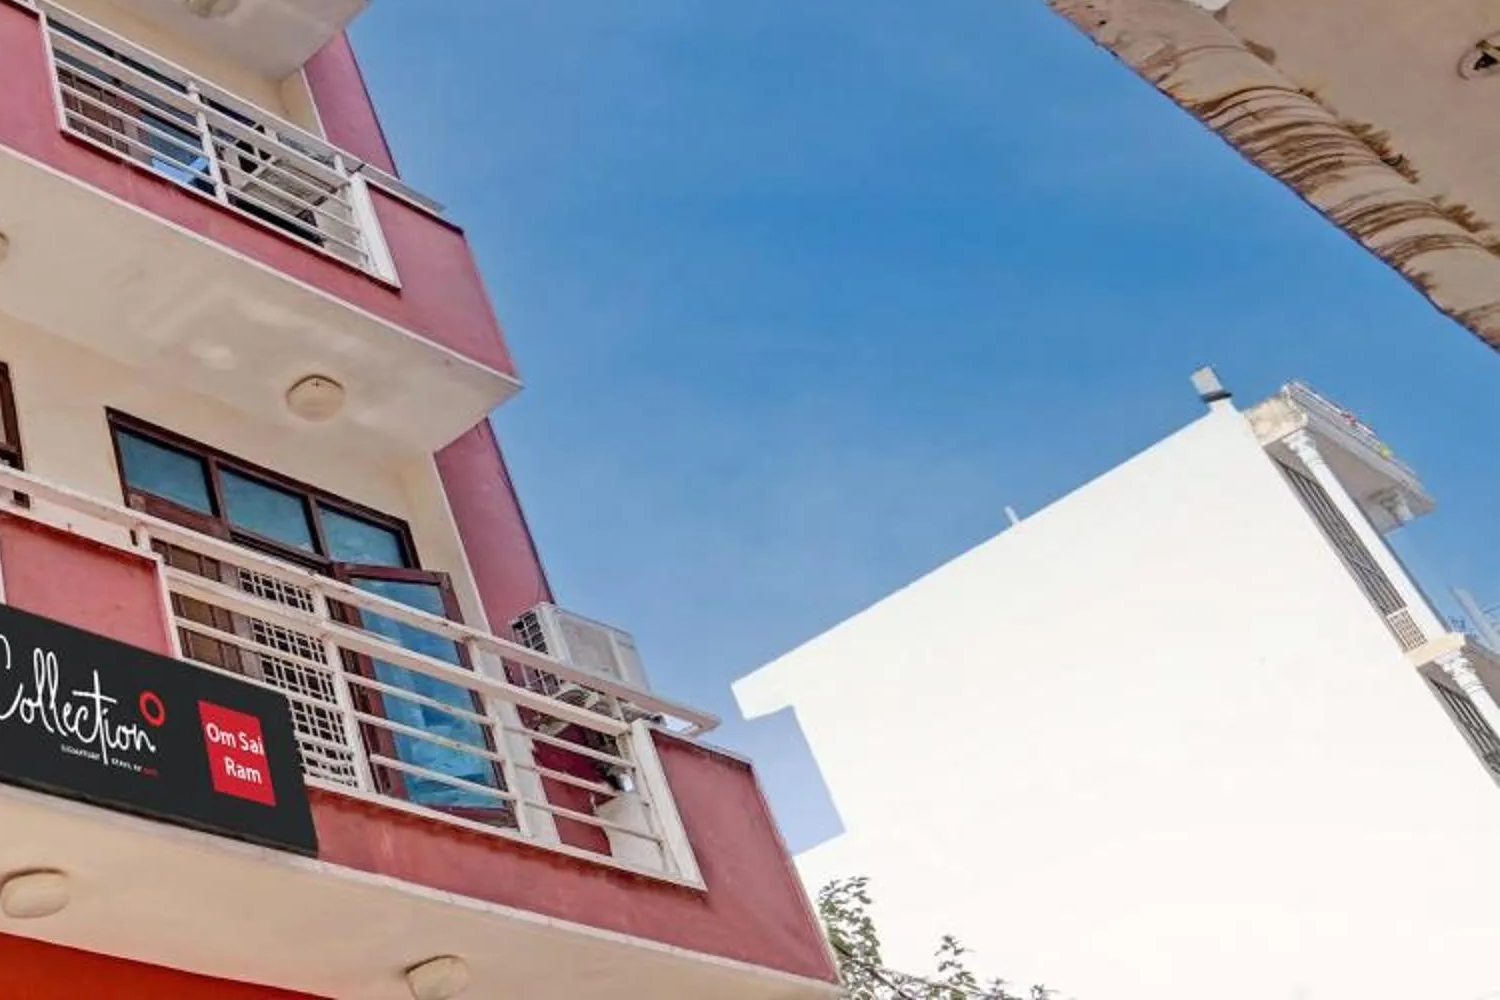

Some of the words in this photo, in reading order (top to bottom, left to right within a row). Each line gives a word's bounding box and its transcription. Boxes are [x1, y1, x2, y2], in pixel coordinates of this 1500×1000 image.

[206, 722, 236, 748] Om
[238, 731, 265, 756] Sai
[224, 756, 262, 784] Ram
